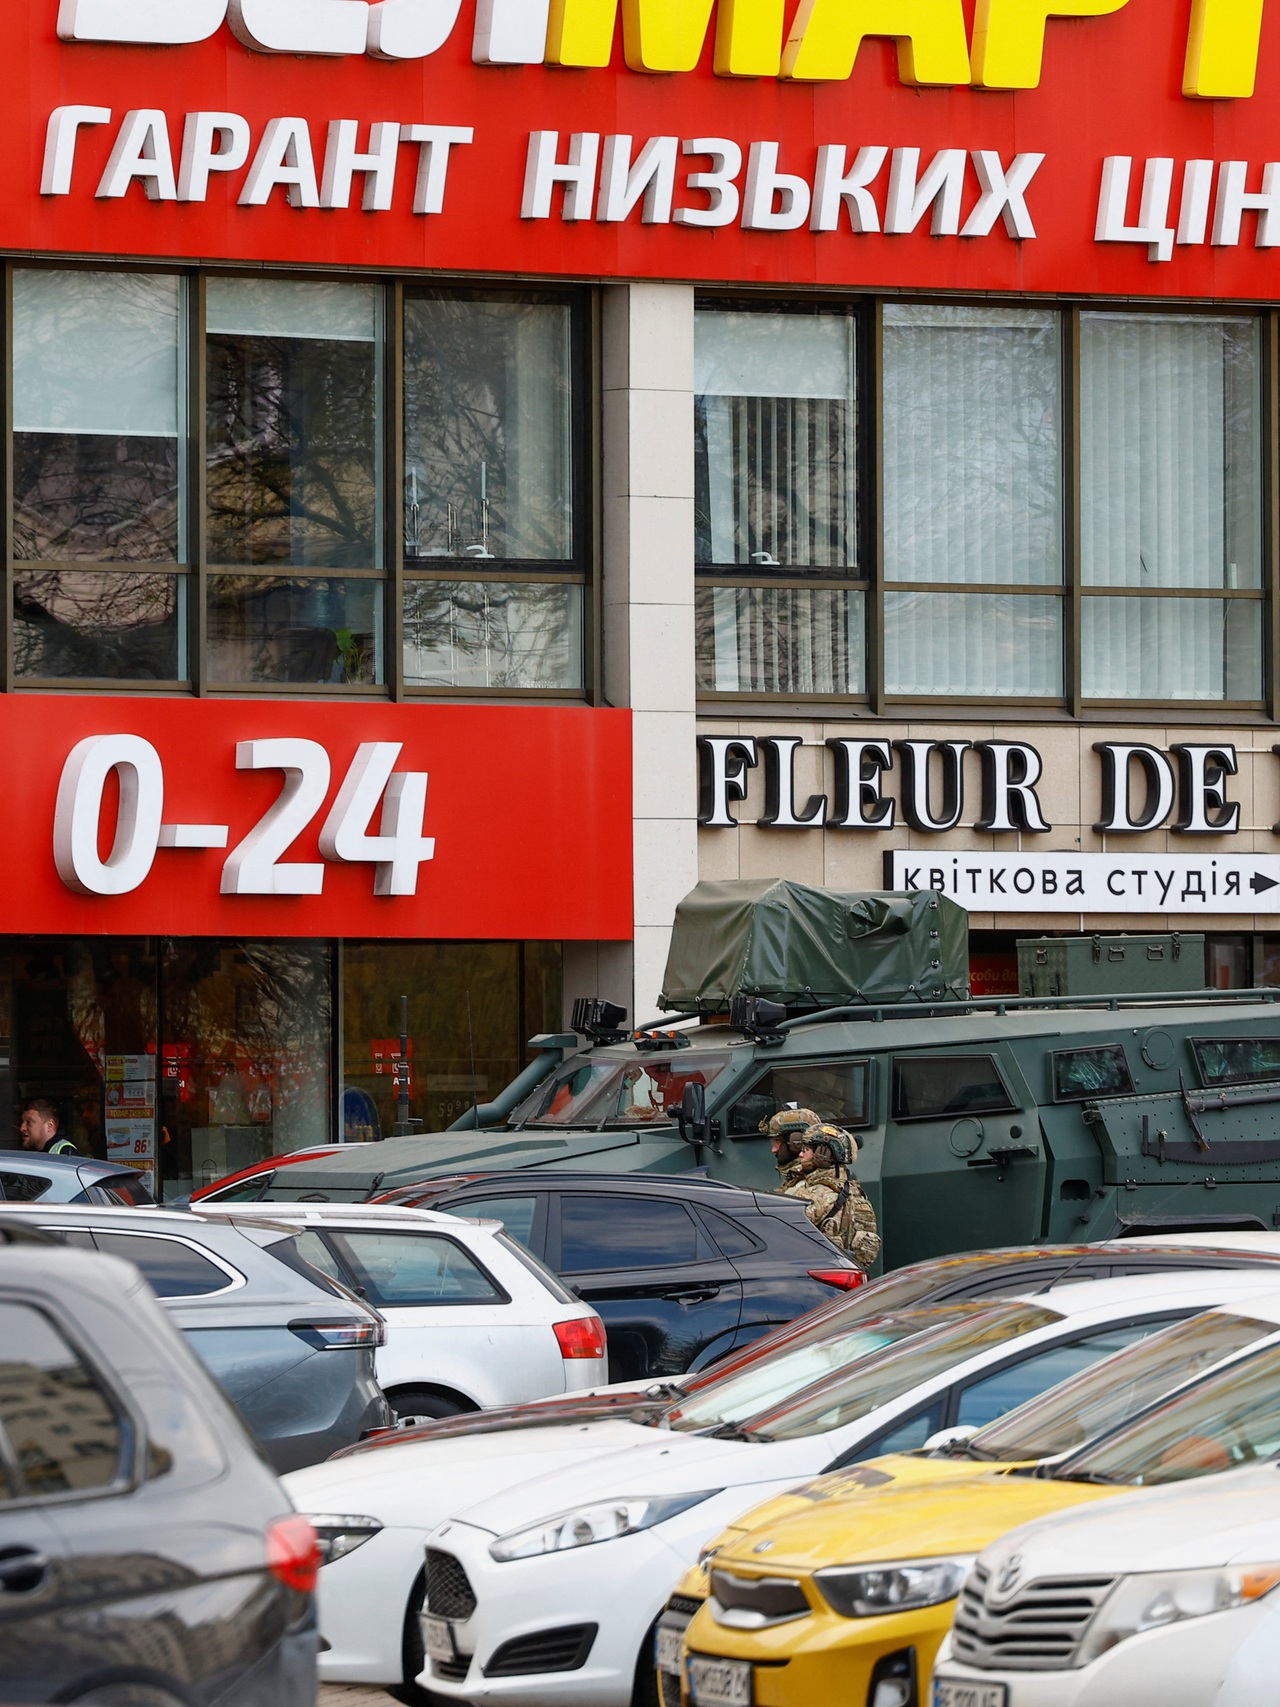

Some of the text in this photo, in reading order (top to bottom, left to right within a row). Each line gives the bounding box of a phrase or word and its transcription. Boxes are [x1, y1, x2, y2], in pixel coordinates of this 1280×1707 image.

[39, 104, 1280, 263] ГАРАНТ НИЗЬКИХ ЦІН
[53, 733, 436, 896] 0-24
[697, 735, 1052, 833] FLEUR
[1092, 741, 1241, 835] DE
[904, 858, 1240, 905] квіткова студія
[134, 1139, 147, 1153] 86
